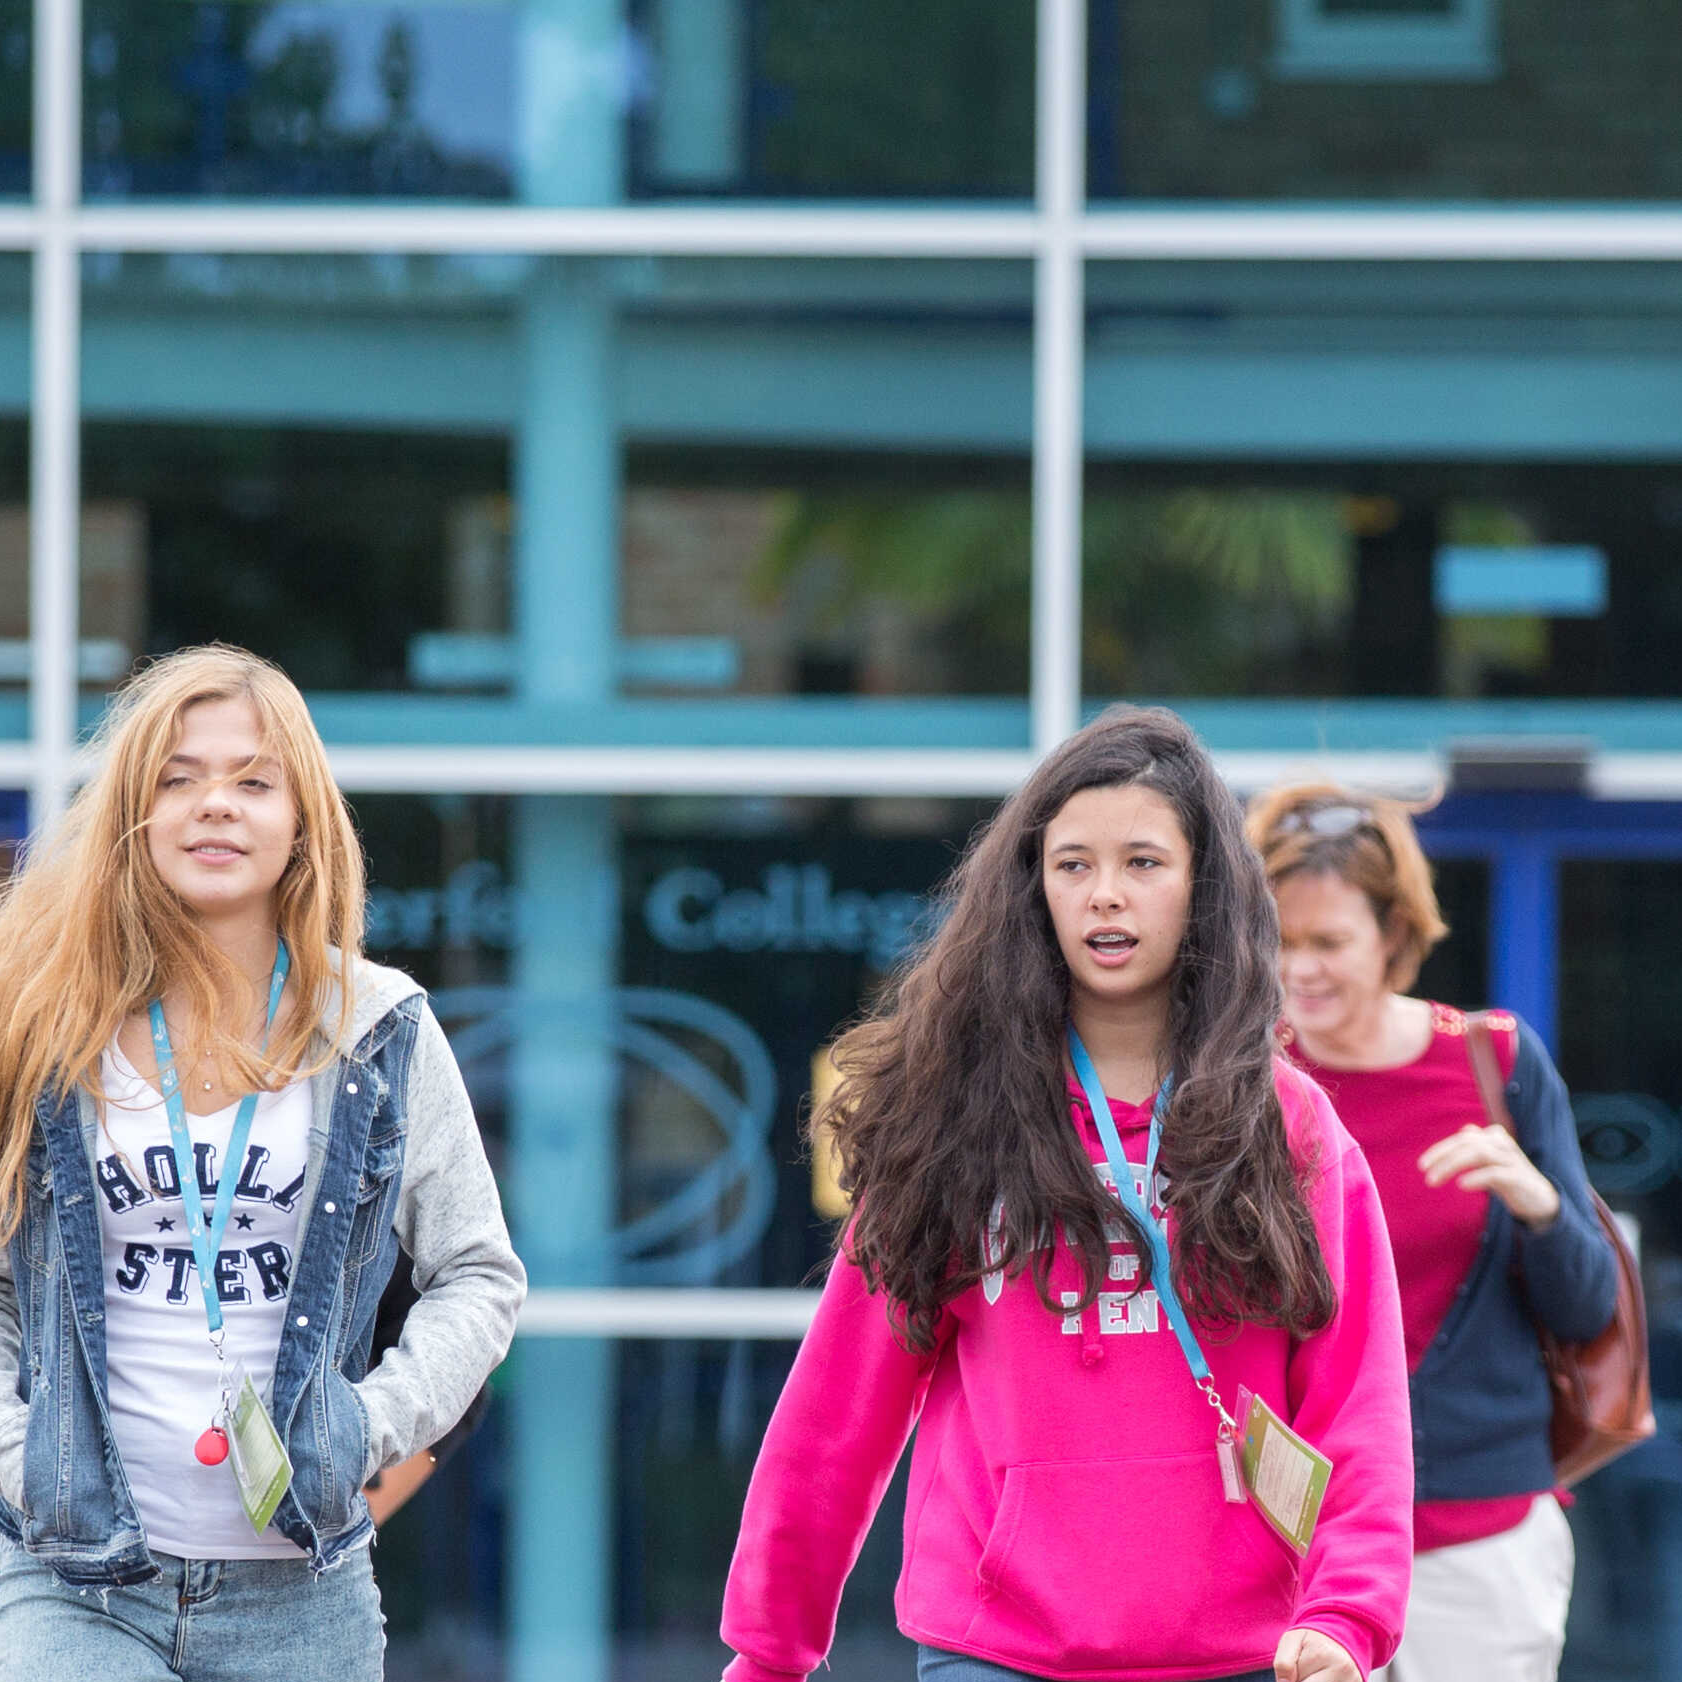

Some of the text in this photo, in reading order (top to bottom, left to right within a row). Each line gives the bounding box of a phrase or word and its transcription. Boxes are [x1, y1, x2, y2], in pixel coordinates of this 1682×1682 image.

[116, 1241, 292, 1305] STER
[1109, 1254, 1140, 1280] OF
[1061, 1289, 1180, 1334] EN
